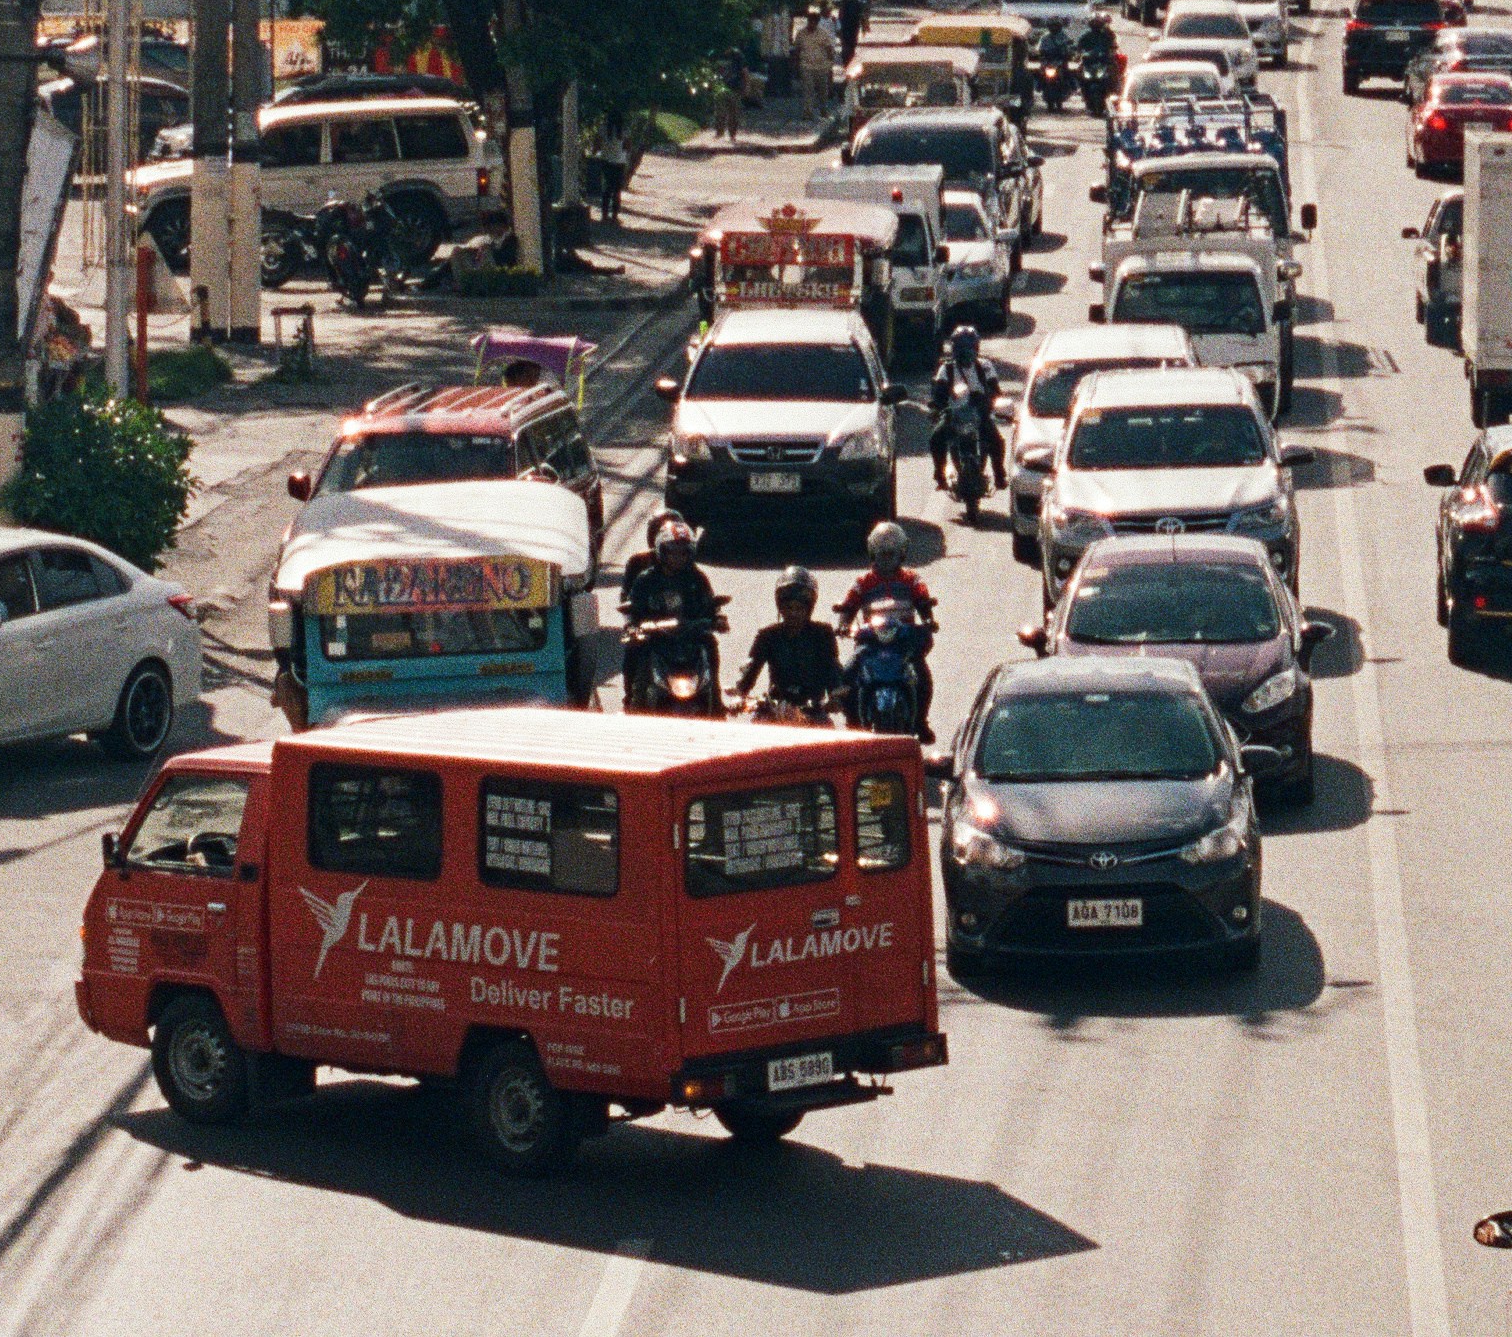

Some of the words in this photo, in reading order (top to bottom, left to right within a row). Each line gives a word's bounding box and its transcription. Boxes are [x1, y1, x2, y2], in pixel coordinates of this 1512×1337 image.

[357, 913, 561, 973] LALAMOVE
[750, 922, 894, 967] LALAMOVE
[470, 977, 551, 1010] Deliver
[559, 986, 635, 1019] Faster
